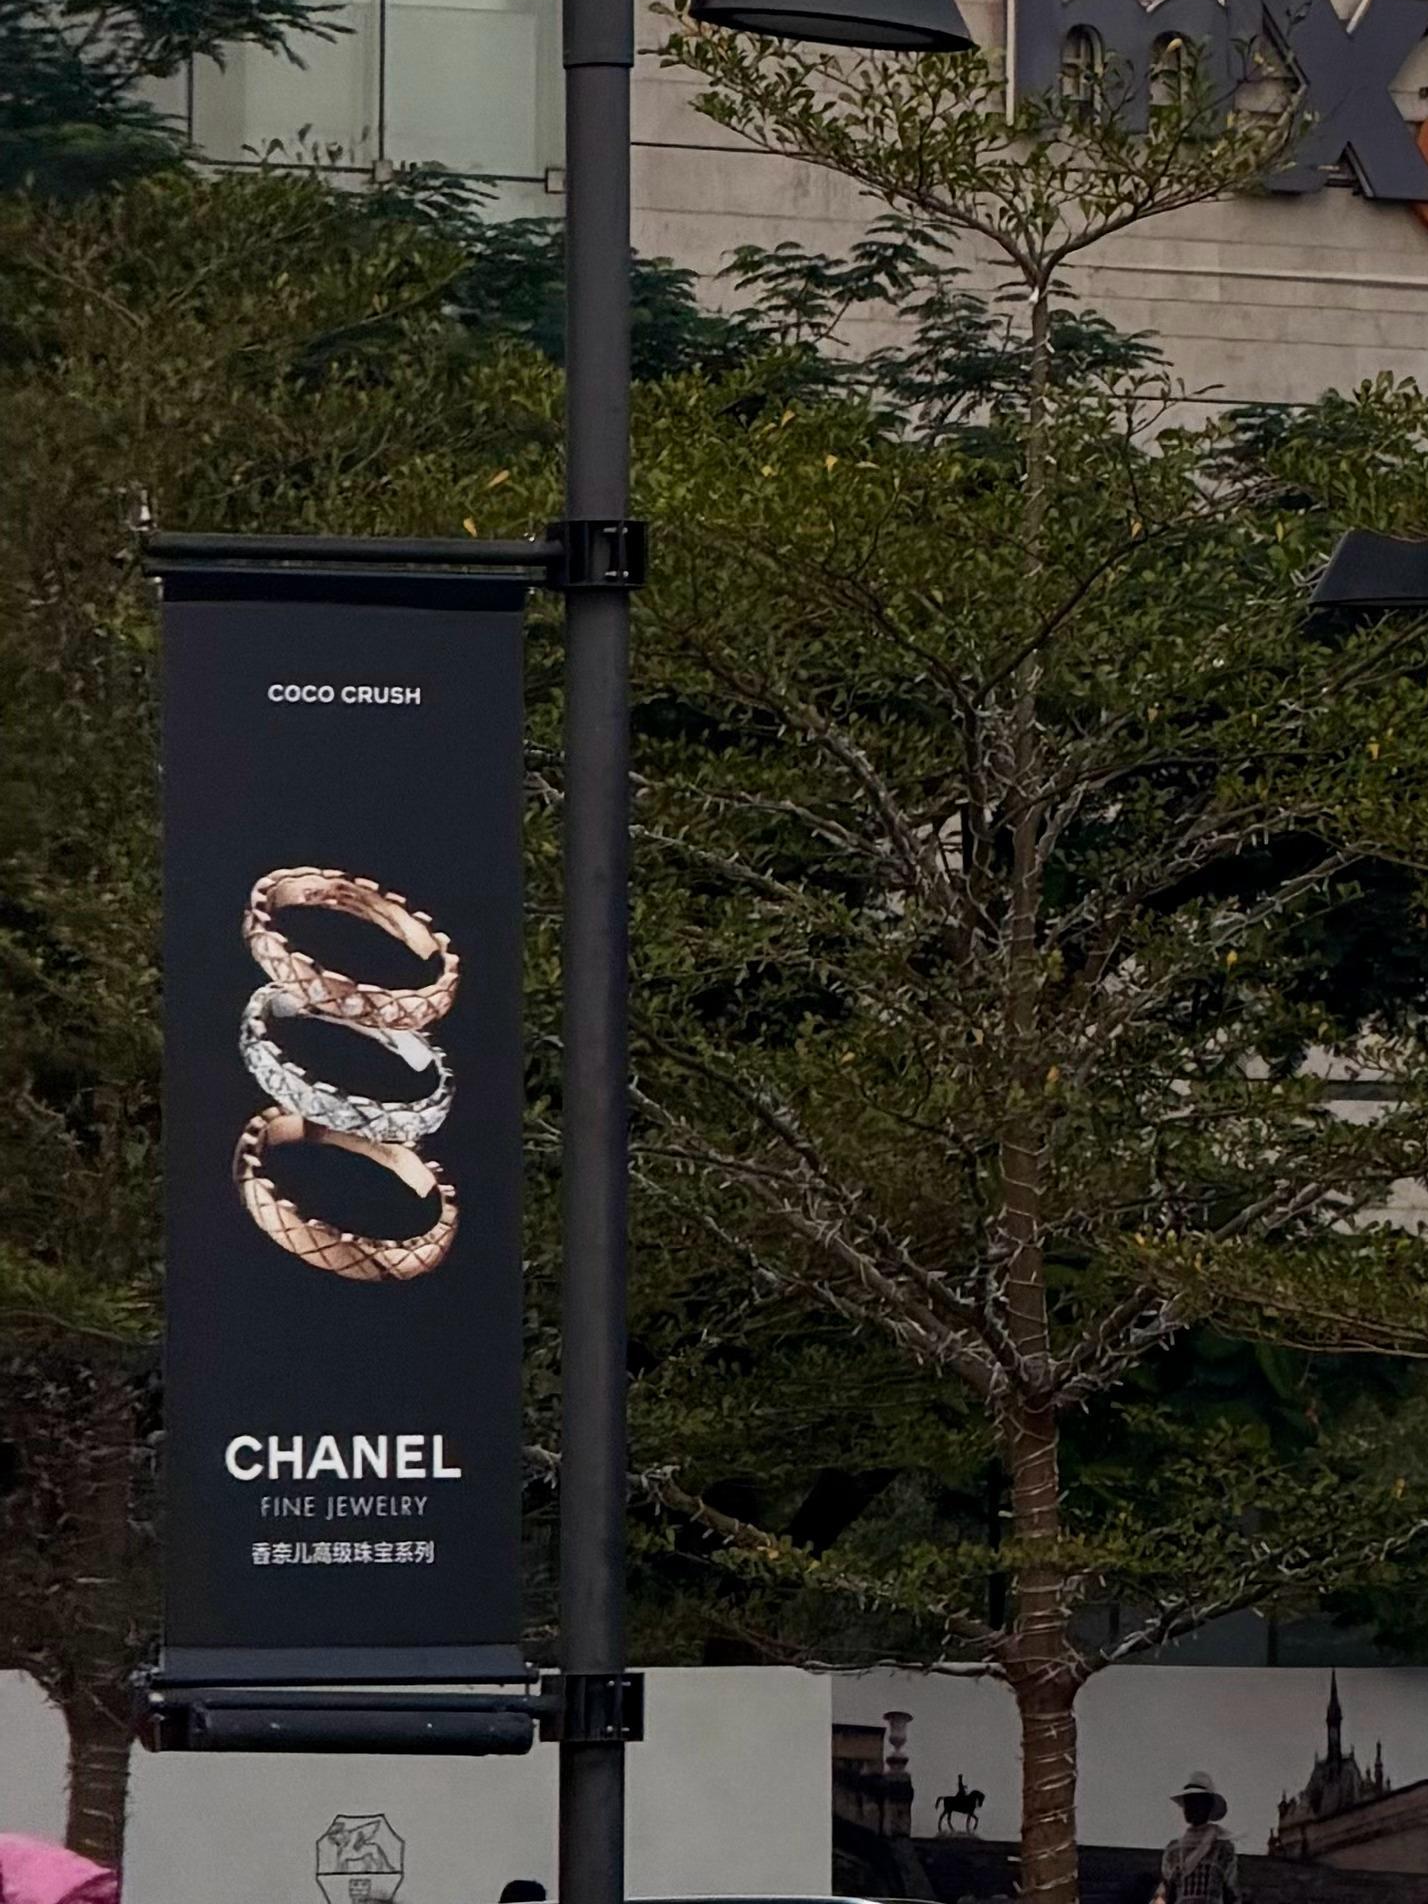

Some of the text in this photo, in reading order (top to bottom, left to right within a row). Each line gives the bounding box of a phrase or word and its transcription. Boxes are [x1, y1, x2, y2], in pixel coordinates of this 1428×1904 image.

[267, 684, 421, 705] COCO CRUSH
[225, 1434, 462, 1481] CHANEL
[260, 1496, 428, 1520] FINE JEWELRY
[251, 1541, 435, 1565] 香奈儿高级珠宝系列
